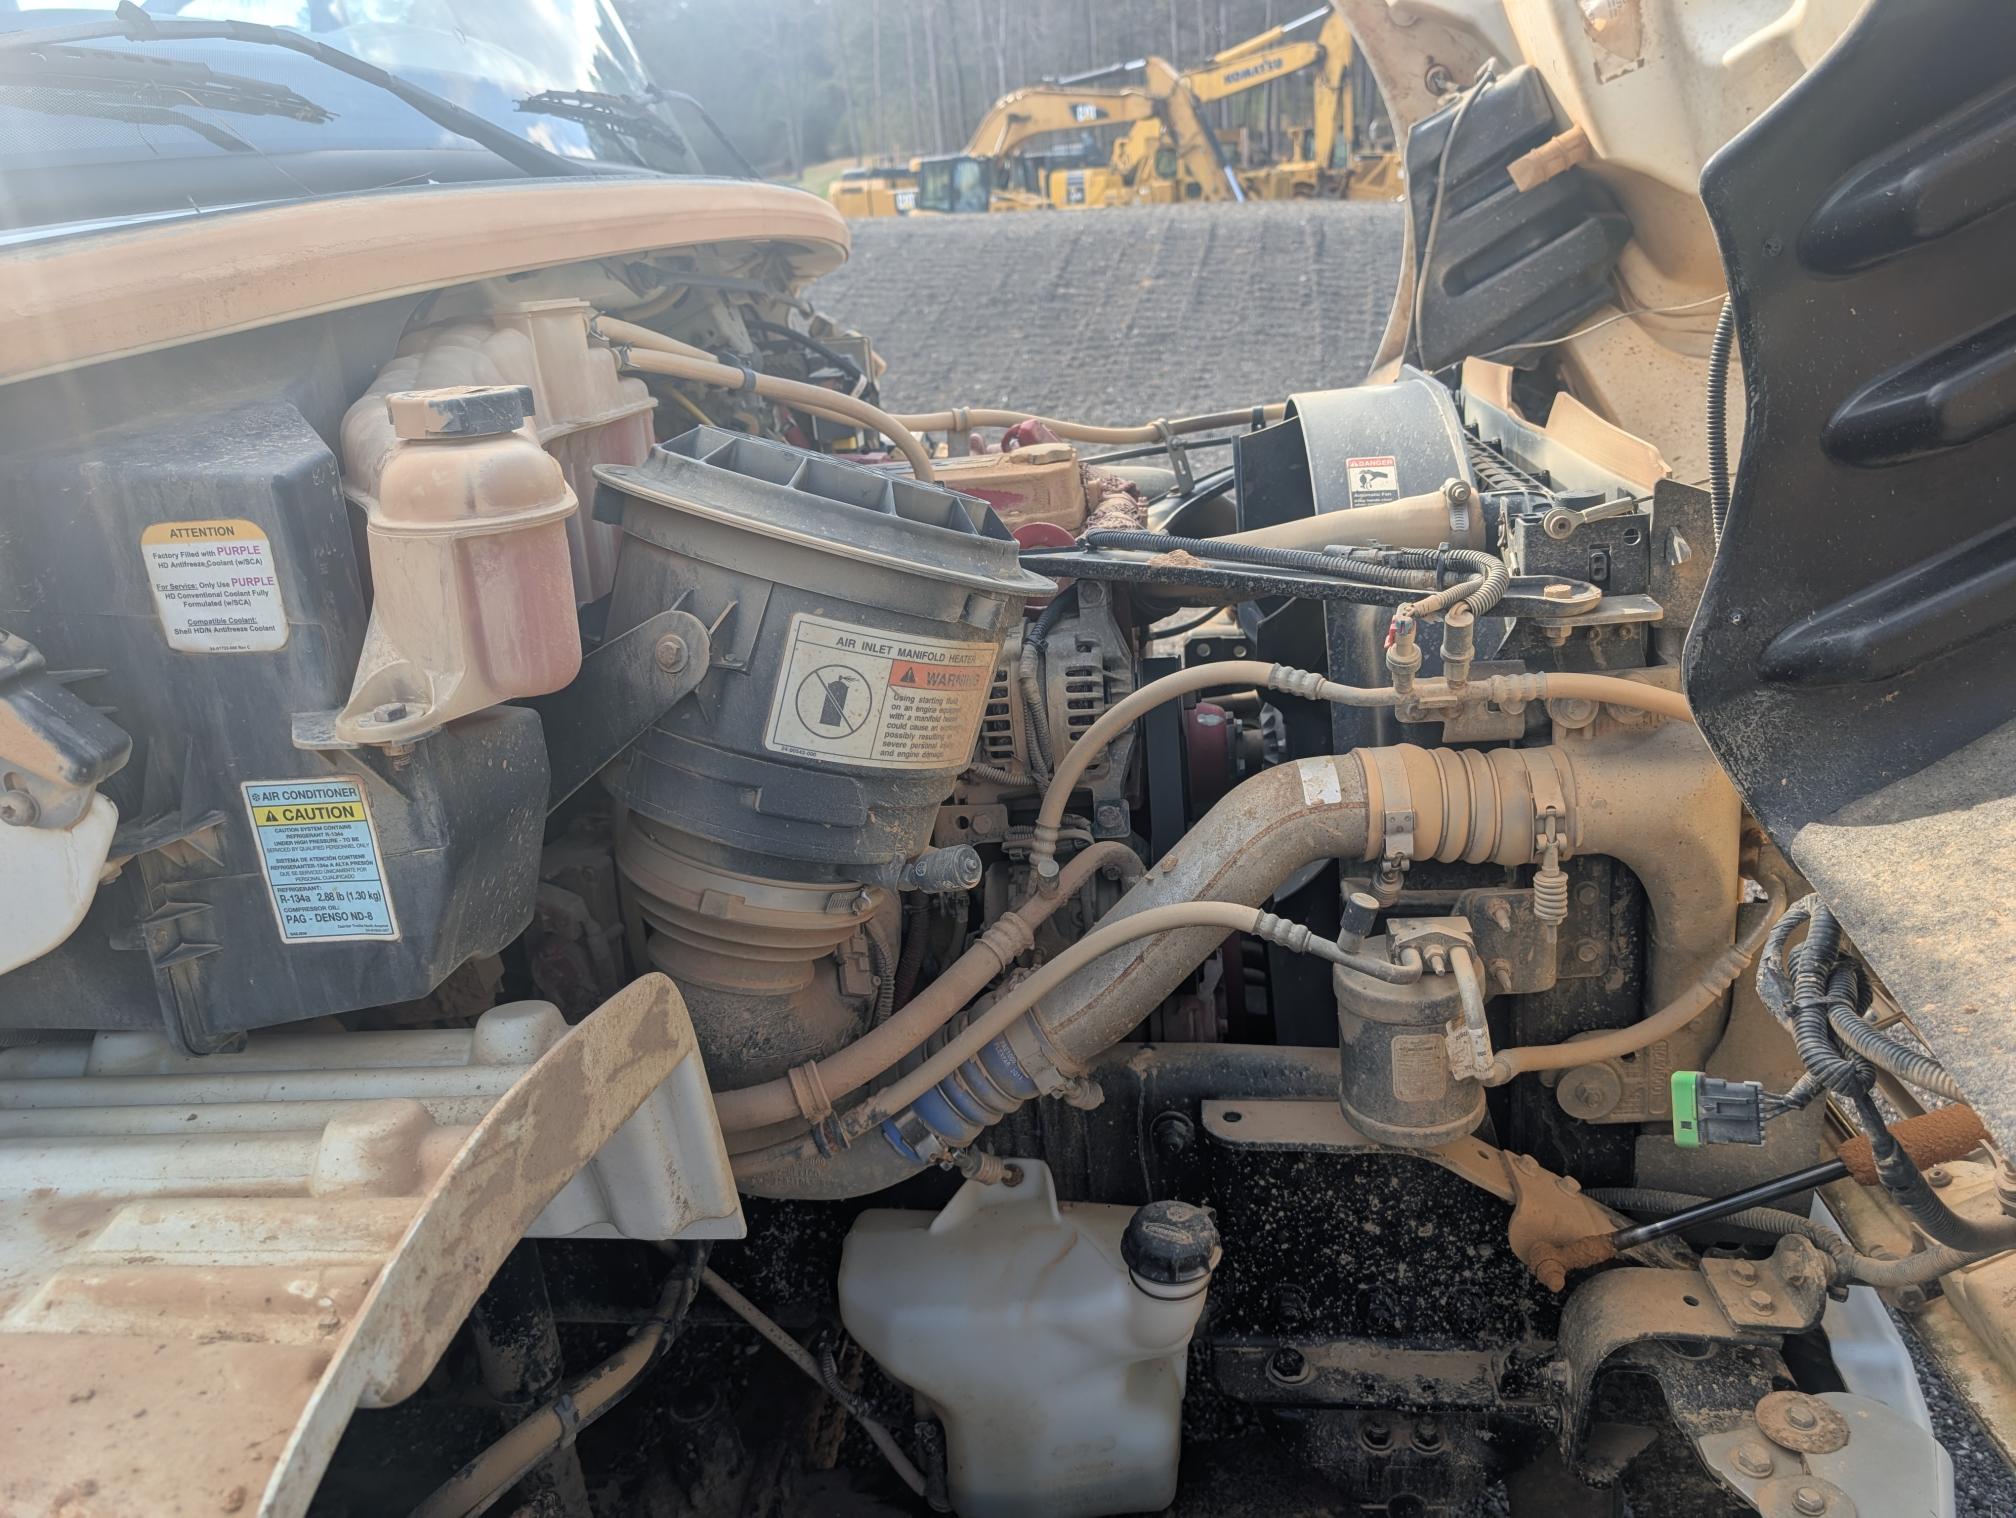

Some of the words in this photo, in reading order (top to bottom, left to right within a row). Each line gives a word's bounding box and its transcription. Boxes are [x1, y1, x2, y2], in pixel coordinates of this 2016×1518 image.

[170, 526, 235, 538] ATTENTION
[152, 552, 179, 560] Factory
[216, 546, 261, 556] PURPLE
[206, 560, 234, 568] Coolant
[236, 558, 263, 566] (w/SCA)
[156, 584, 168, 592] For
[170, 582, 198, 590] Service:
[199, 582, 216, 590] Only
[231, 576, 275, 587] PURPLE
[177, 591, 222, 599] Conventional
[252, 590, 269, 598] Fully
[224, 599, 252, 608] (w/SCA)
[188, 618, 226, 627] Compatible
[228, 617, 257, 625] Coolant:
[836, 637, 856, 648] AIR
[861, 641, 892, 655] INLET
[897, 648, 945, 662] MANIFOLD
[949, 652, 976, 664] HEATER
[926, 672, 981, 686] WARNING
[894, 694, 916, 702] Using
[918, 696, 943, 706] starting
[887, 722, 907, 730] could
[884, 731, 916, 740] possibly
[897, 751, 920, 759] engine
[262, 792, 280, 801] AIR
[282, 788, 357, 800] CONDITIONER
[282, 805, 355, 822] CAUTION
[280, 894, 311, 904] R-134a
[316, 892, 334, 902] 2.88
[336, 892, 344, 900] lb
[346, 891, 366, 902] (1.30
[368, 890, 381, 902] kg)
[286, 914, 307, 924] PAG
[314, 912, 348, 922] DENSO
[350, 912, 373, 920] ND-8
